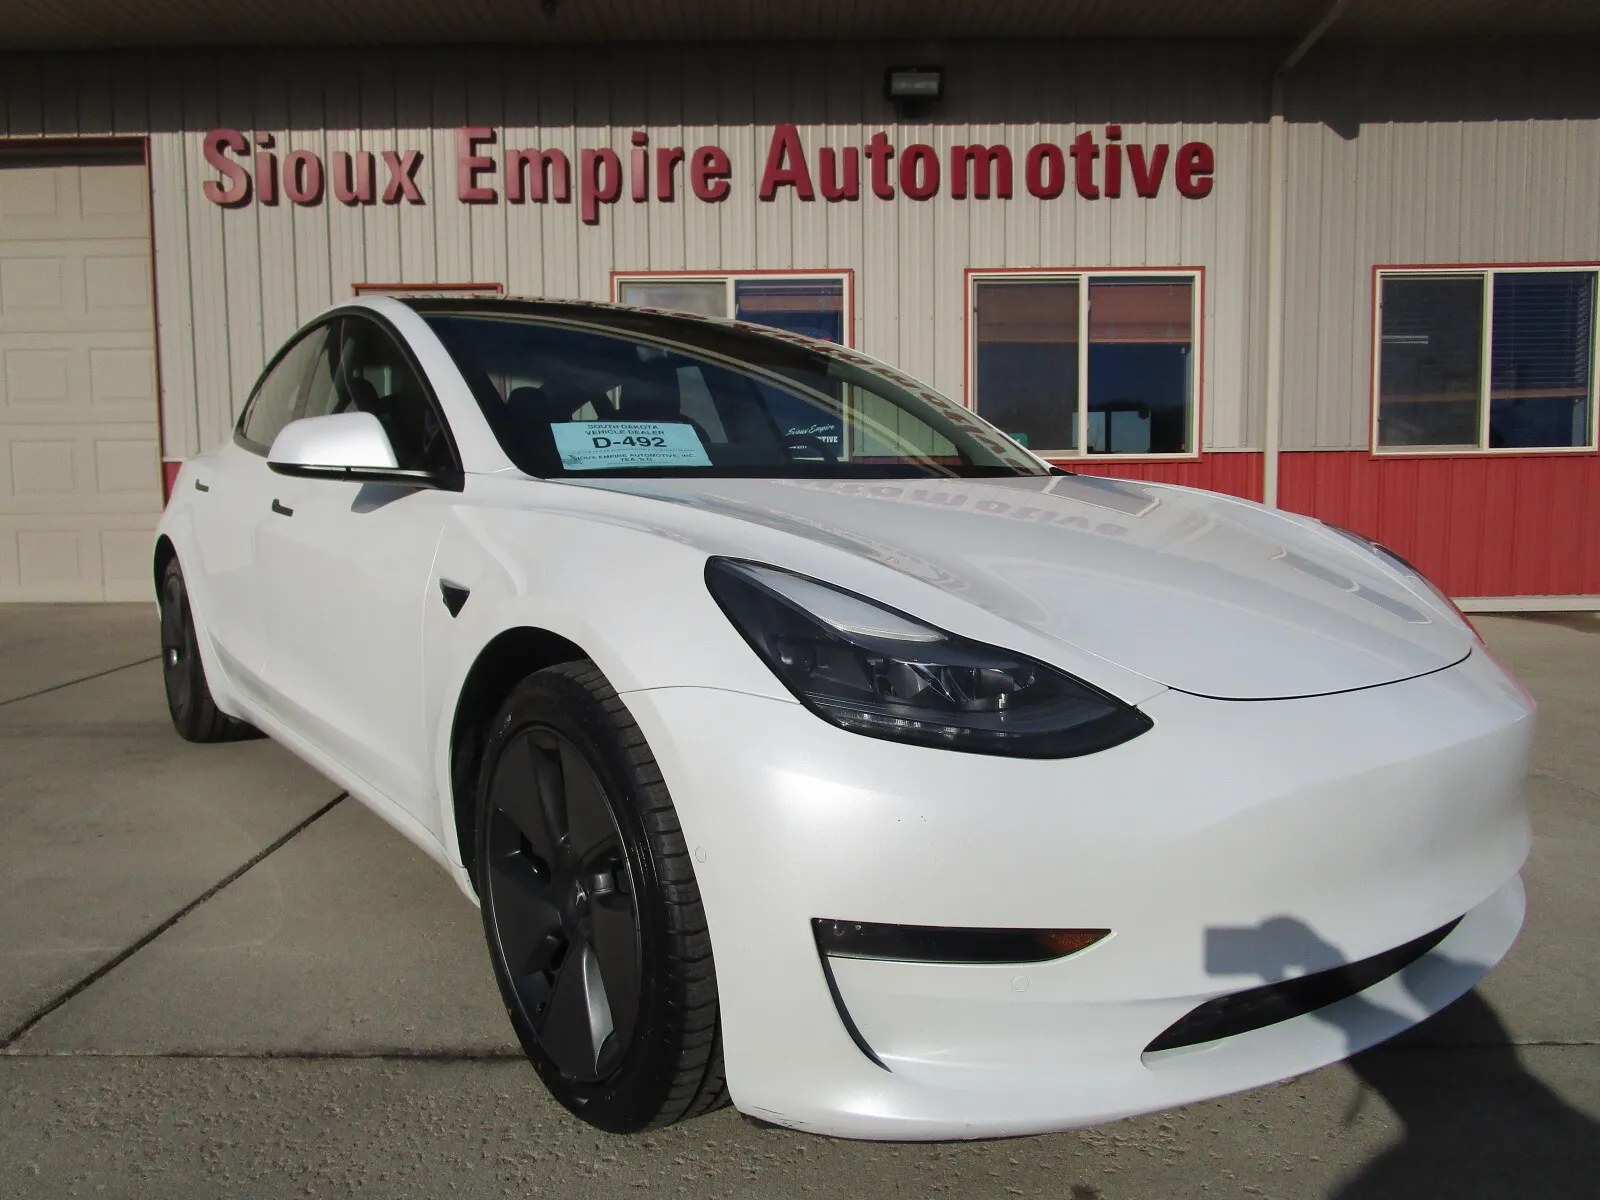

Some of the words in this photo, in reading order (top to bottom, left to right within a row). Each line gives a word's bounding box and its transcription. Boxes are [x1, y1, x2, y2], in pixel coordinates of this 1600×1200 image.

[203, 127, 425, 208] Sioux
[457, 126, 731, 225] Empire
[758, 123, 1216, 202] Automotive
[592, 436, 668, 449] D-492
